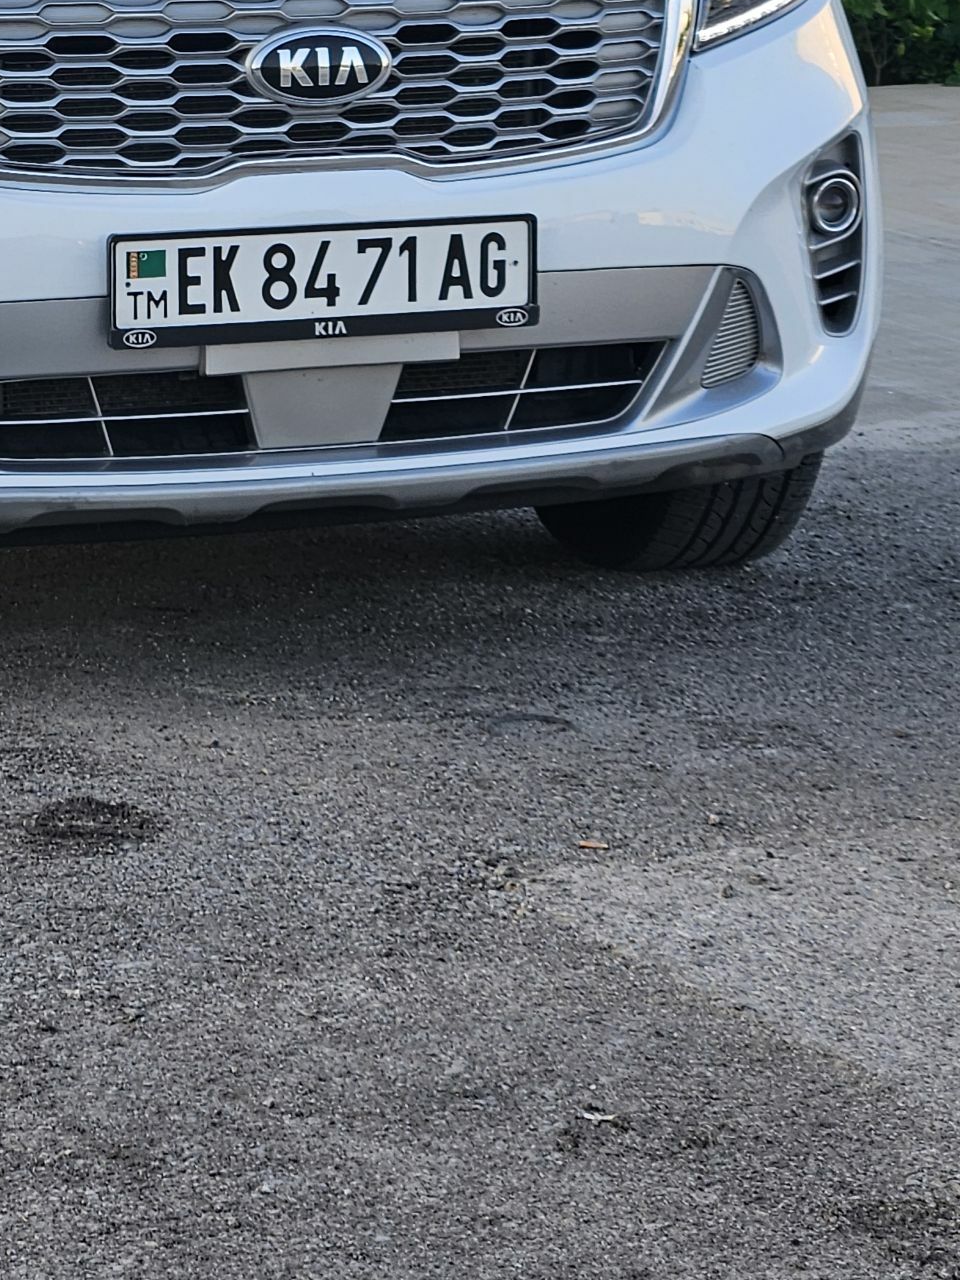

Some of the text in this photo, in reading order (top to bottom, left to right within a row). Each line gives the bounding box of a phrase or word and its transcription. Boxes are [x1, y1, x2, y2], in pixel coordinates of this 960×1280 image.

[277, 46, 369, 88] KIA
[178, 232, 506, 315] EK 8471 AG
[126, 290, 168, 320] TM
[314, 320, 347, 336] KIA
[501, 312, 524, 322] KIA
[129, 333, 152, 344] KIA
